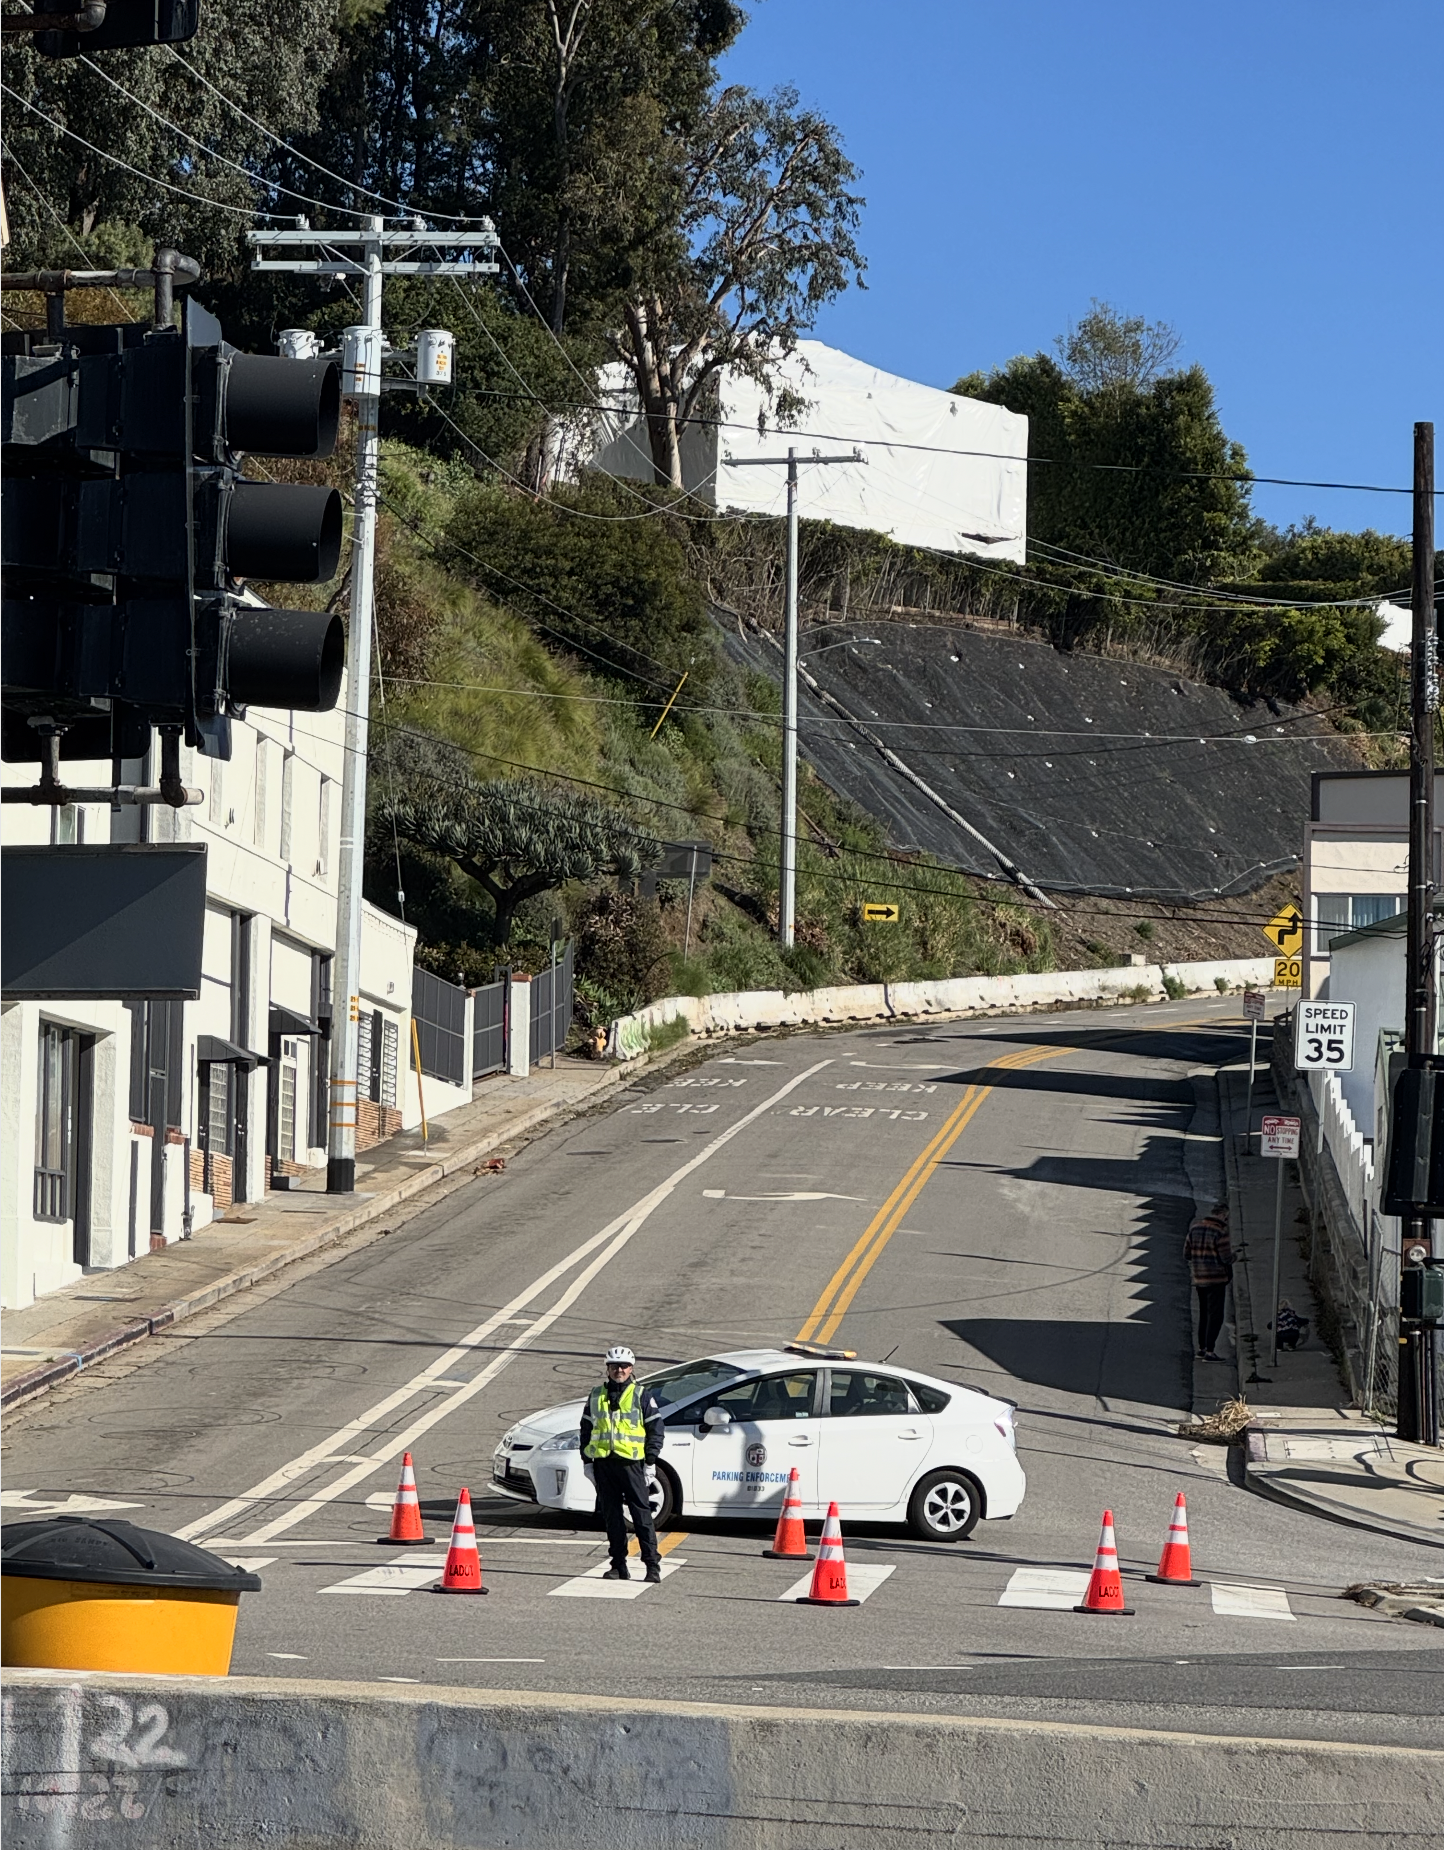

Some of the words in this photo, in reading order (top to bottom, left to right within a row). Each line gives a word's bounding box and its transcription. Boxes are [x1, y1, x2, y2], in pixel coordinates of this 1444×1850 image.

[1277, 962, 1300, 977] 20
[1305, 1007, 1349, 1020] SPEED
[1306, 1023, 1346, 1035] LIMIT
[1305, 1038, 1345, 1063] 35
[836, 1082, 938, 1093] KEEP
[790, 1106, 929, 1120] CLEAR
[1264, 1125, 1276, 1135] NO
[1277, 1126, 1298, 1136] STOPPING
[1268, 1136, 1280, 1144] ANY
[1281, 1136, 1294, 1145] TIME
[712, 1471, 744, 1482] PARKING
[449, 1565, 474, 1576] LADOT
